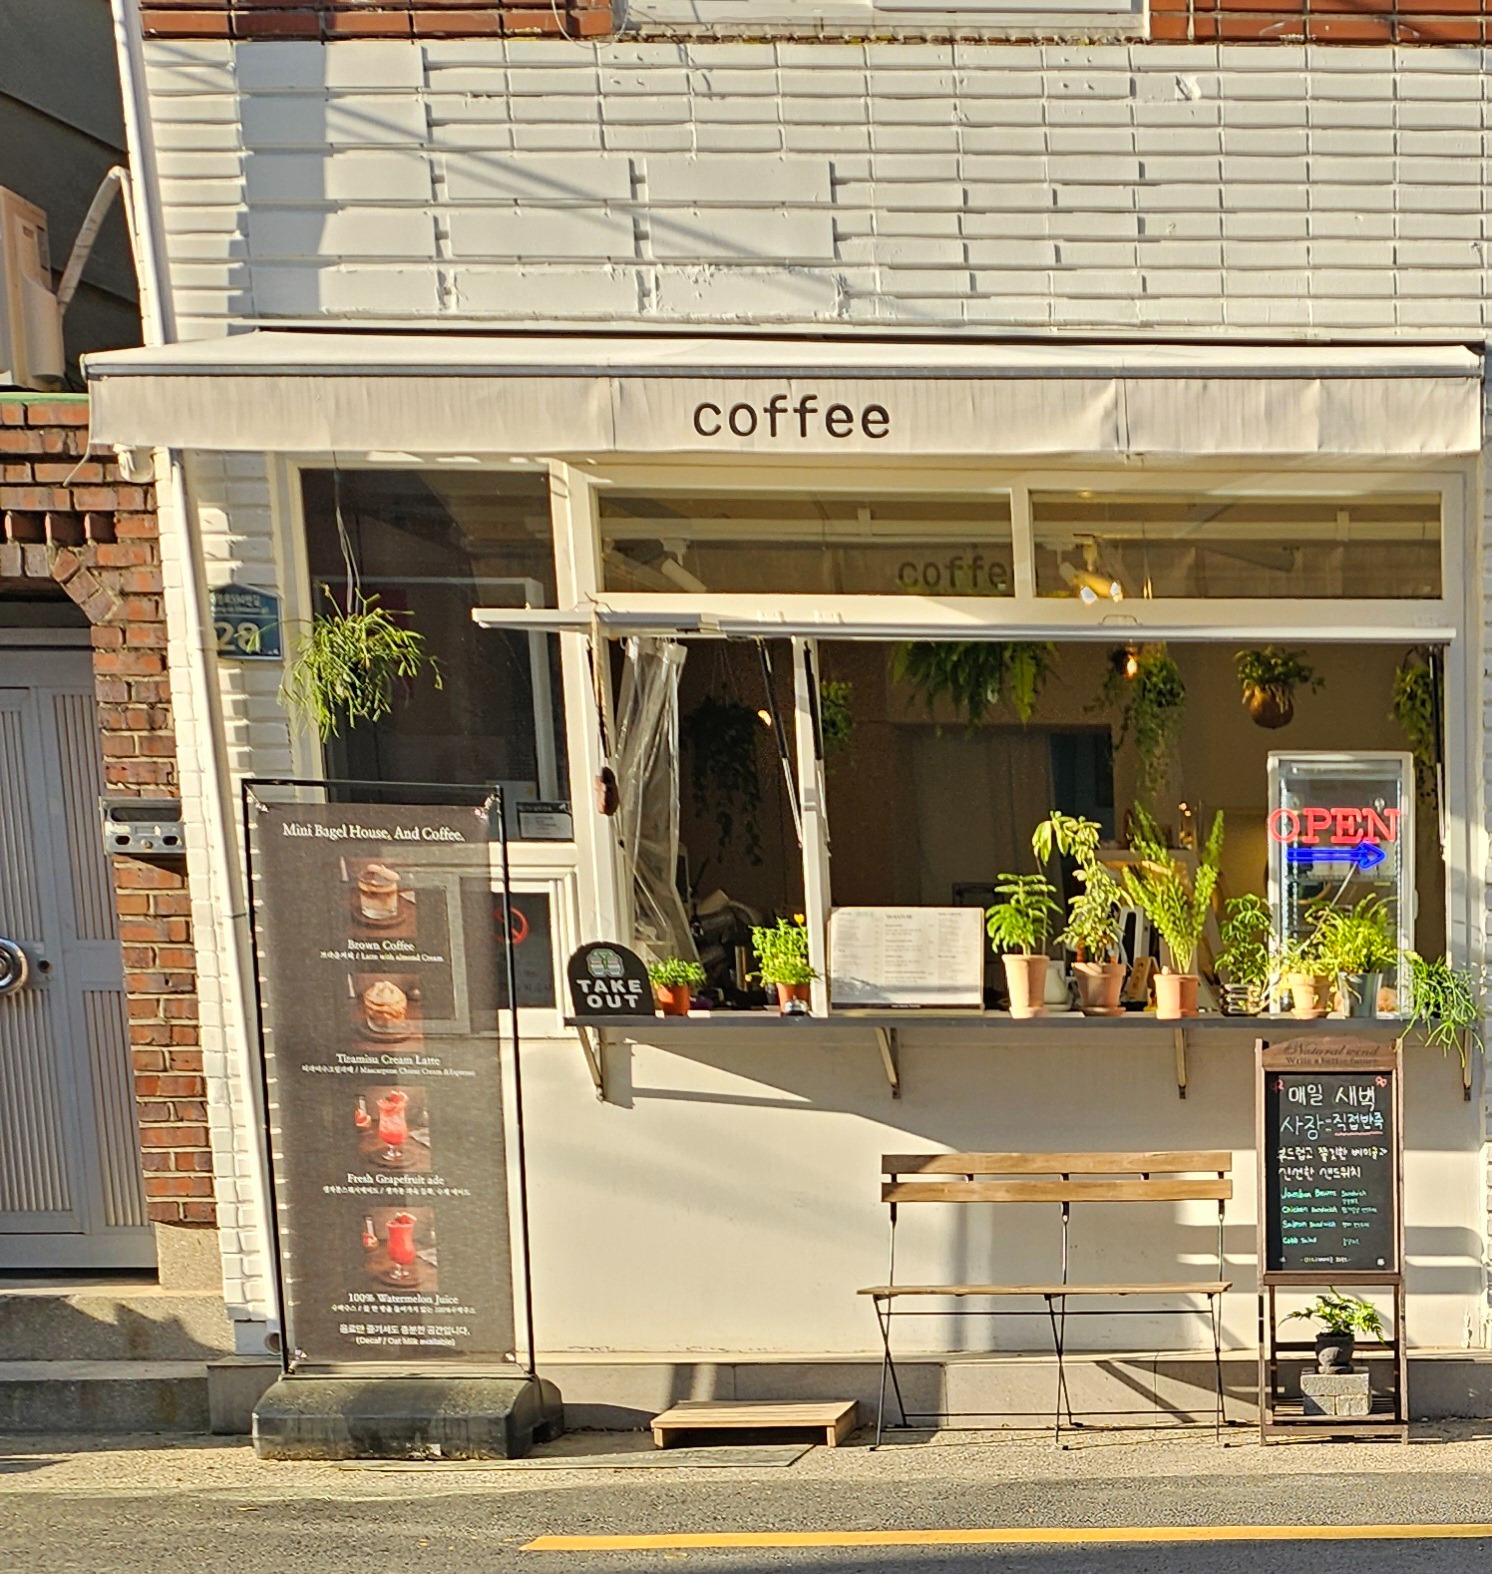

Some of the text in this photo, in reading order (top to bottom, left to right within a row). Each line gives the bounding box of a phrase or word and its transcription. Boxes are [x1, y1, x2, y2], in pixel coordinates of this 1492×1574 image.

[693, 393, 890, 438] coffee
[283, 823, 312, 837] Mini
[315, 824, 347, 841] Bagel
[394, 826, 420, 841] And
[1267, 807, 1403, 844] OPEN
[348, 938, 415, 952] Brown Coffee
[576, 979, 643, 994] TAKE
[586, 994, 638, 1009] OUT
[336, 1053, 441, 1066] Tiramisu Cream Latte
[1288, 1084, 1376, 1112] 매일 새벽
[347, 1172, 445, 1186] Fresh Grapefruit ade
[348, 1293, 459, 1306] 100% Watermelon Juice
[340, 1323, 365, 1335] 음료만
[400, 1325, 425, 1335] 충분한
